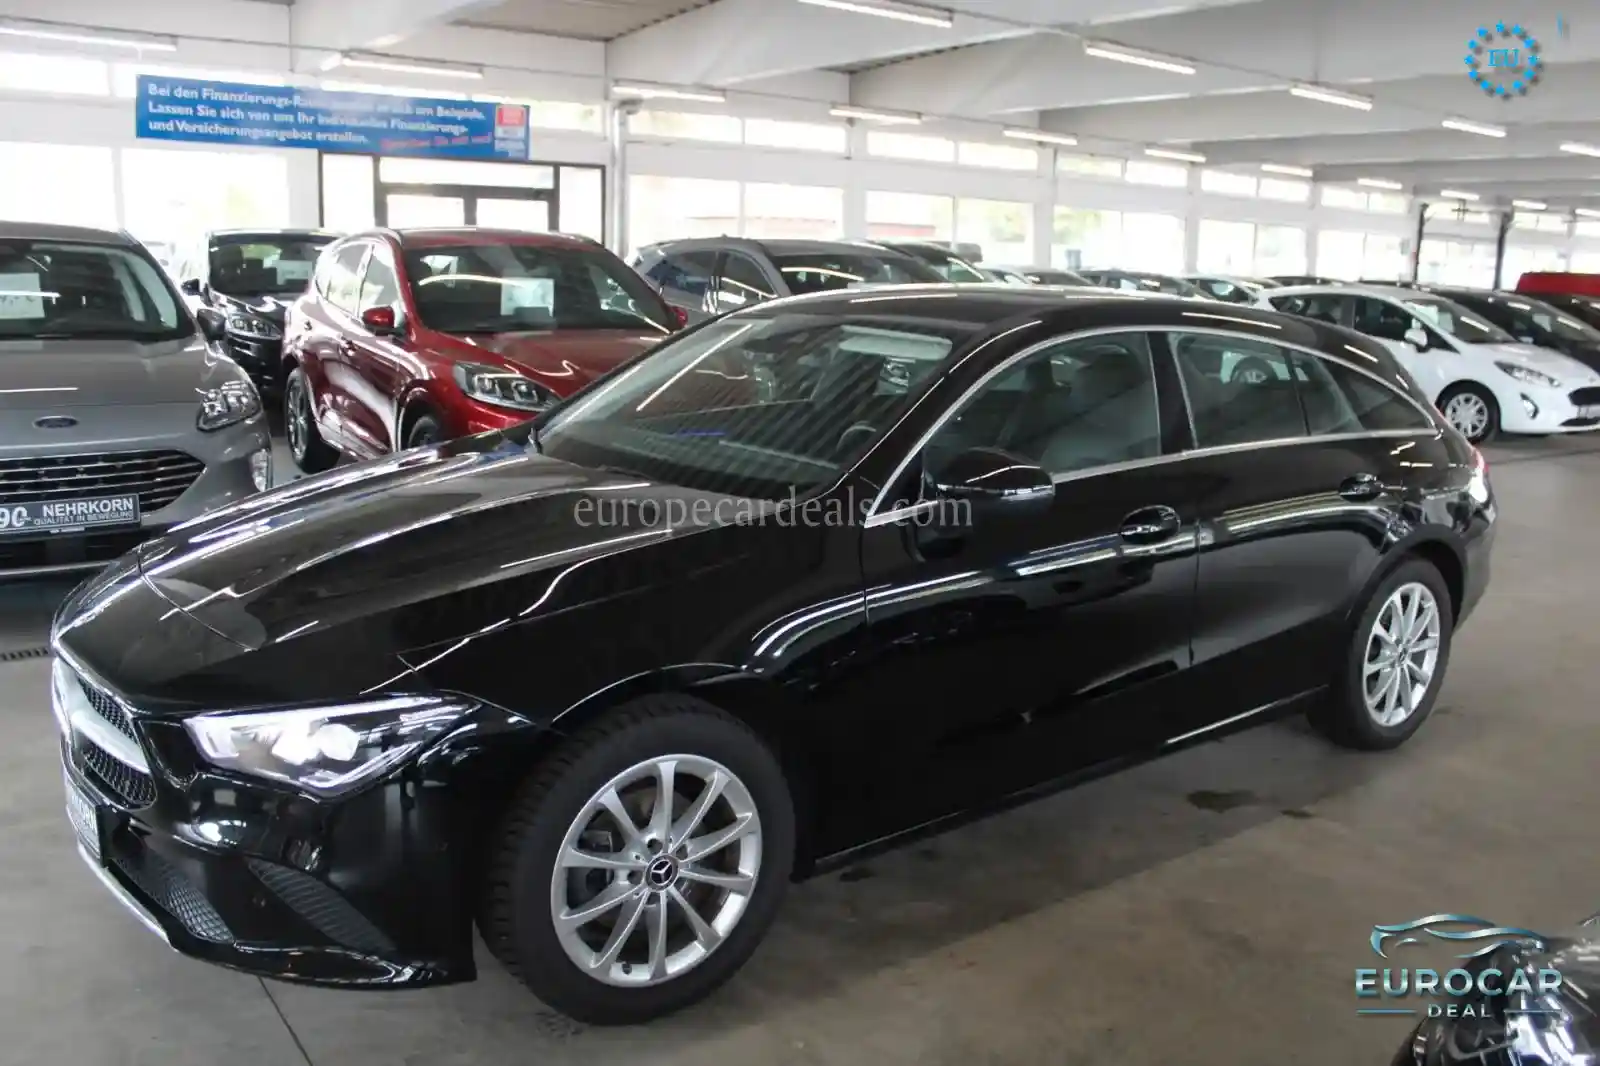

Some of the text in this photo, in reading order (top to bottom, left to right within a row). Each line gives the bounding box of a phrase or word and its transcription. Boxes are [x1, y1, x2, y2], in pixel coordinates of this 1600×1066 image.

[148, 83, 171, 97] Bei
[173, 86, 198, 99] den
[148, 101, 194, 116] Lassen
[196, 104, 217, 117] Sie
[220, 107, 245, 121] sich
[248, 111, 270, 122] von
[297, 111, 315, 125] Ihr
[148, 120, 174, 133] und
[175, 120, 313, 142] Versicherungsangebot
[42, 497, 134, 518] NEHRKORN
